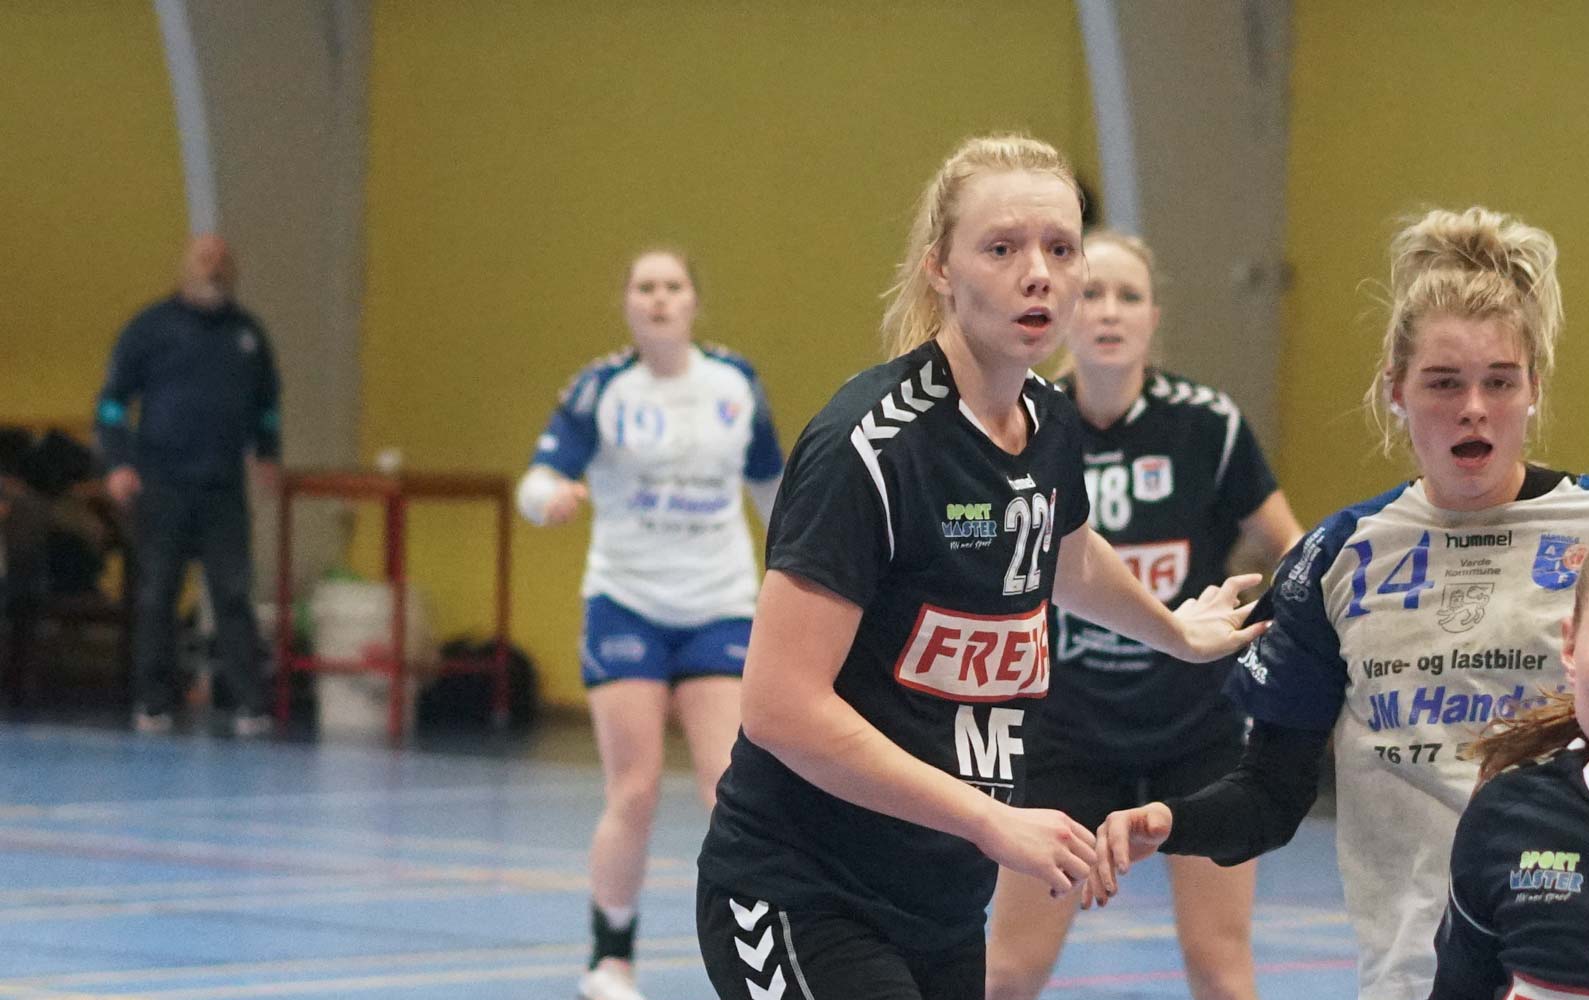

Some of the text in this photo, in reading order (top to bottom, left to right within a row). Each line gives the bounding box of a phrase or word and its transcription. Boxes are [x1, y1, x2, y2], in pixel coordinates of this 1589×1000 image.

[946, 503, 992, 520] SPORT
[941, 520, 997, 538] MASTER
[1444, 529, 1512, 549] hummel
[1003, 492, 1050, 596] 22
[1444, 567, 1502, 577] Kommune
[1460, 558, 1492, 567] Varde
[1346, 530, 1436, 619] 14
[1363, 649, 1548, 680] Vare- og lastbiler
[1367, 685, 1547, 733] JM Hand
[954, 704, 1025, 781] MF
[1374, 745, 1401, 765] 76
[1409, 743, 1443, 764] 77
[1519, 850, 1581, 872] SPORT
[1509, 868, 1585, 893] MASTER
